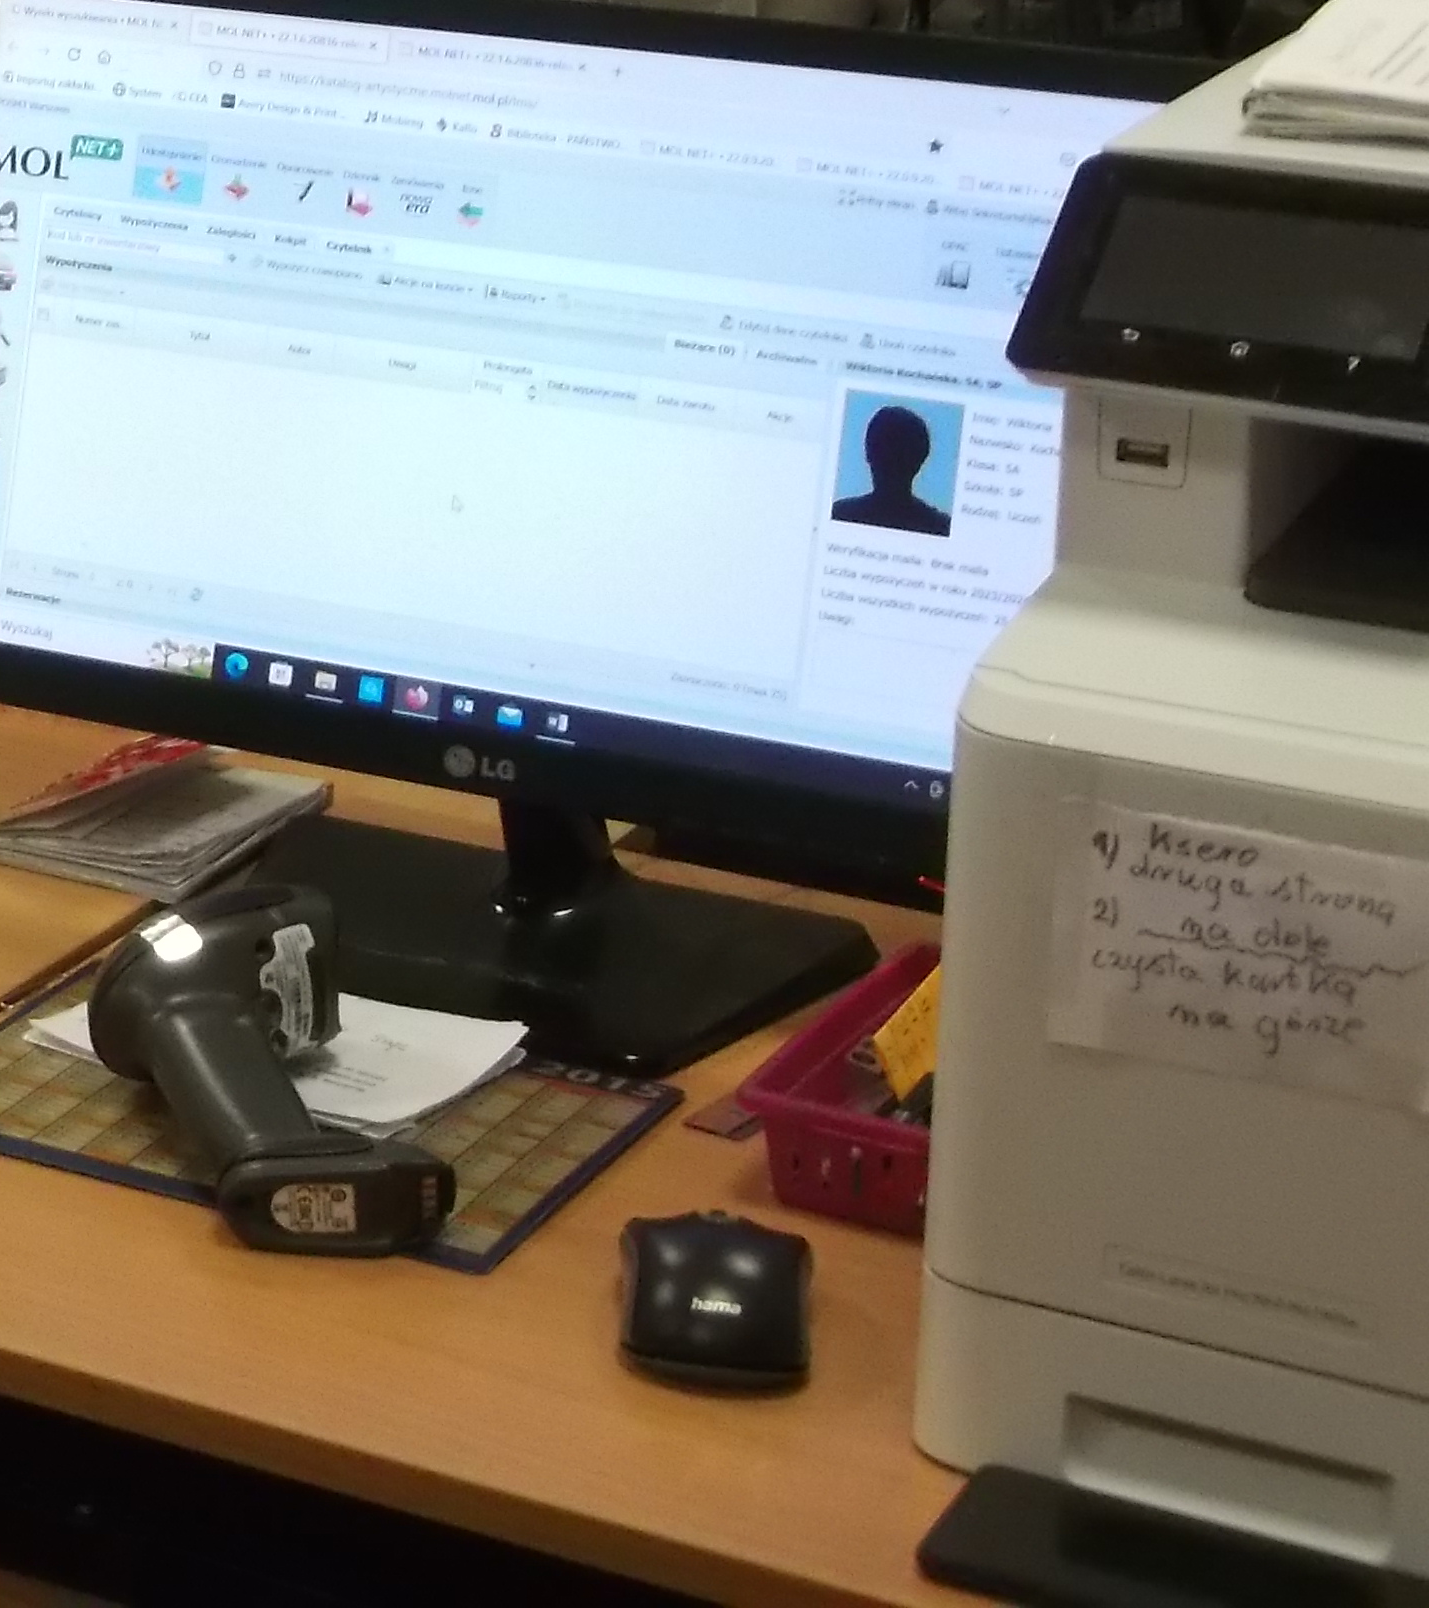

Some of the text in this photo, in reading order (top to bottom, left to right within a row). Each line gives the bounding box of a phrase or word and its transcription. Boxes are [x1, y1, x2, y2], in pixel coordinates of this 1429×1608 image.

[74, 138, 120, 160] NET+
[0, 617, 54, 642] Wyszukaj
[479, 756, 517, 782] LG
[1092, 895, 1120, 929] 2)
[690, 1295, 742, 1315] hama
